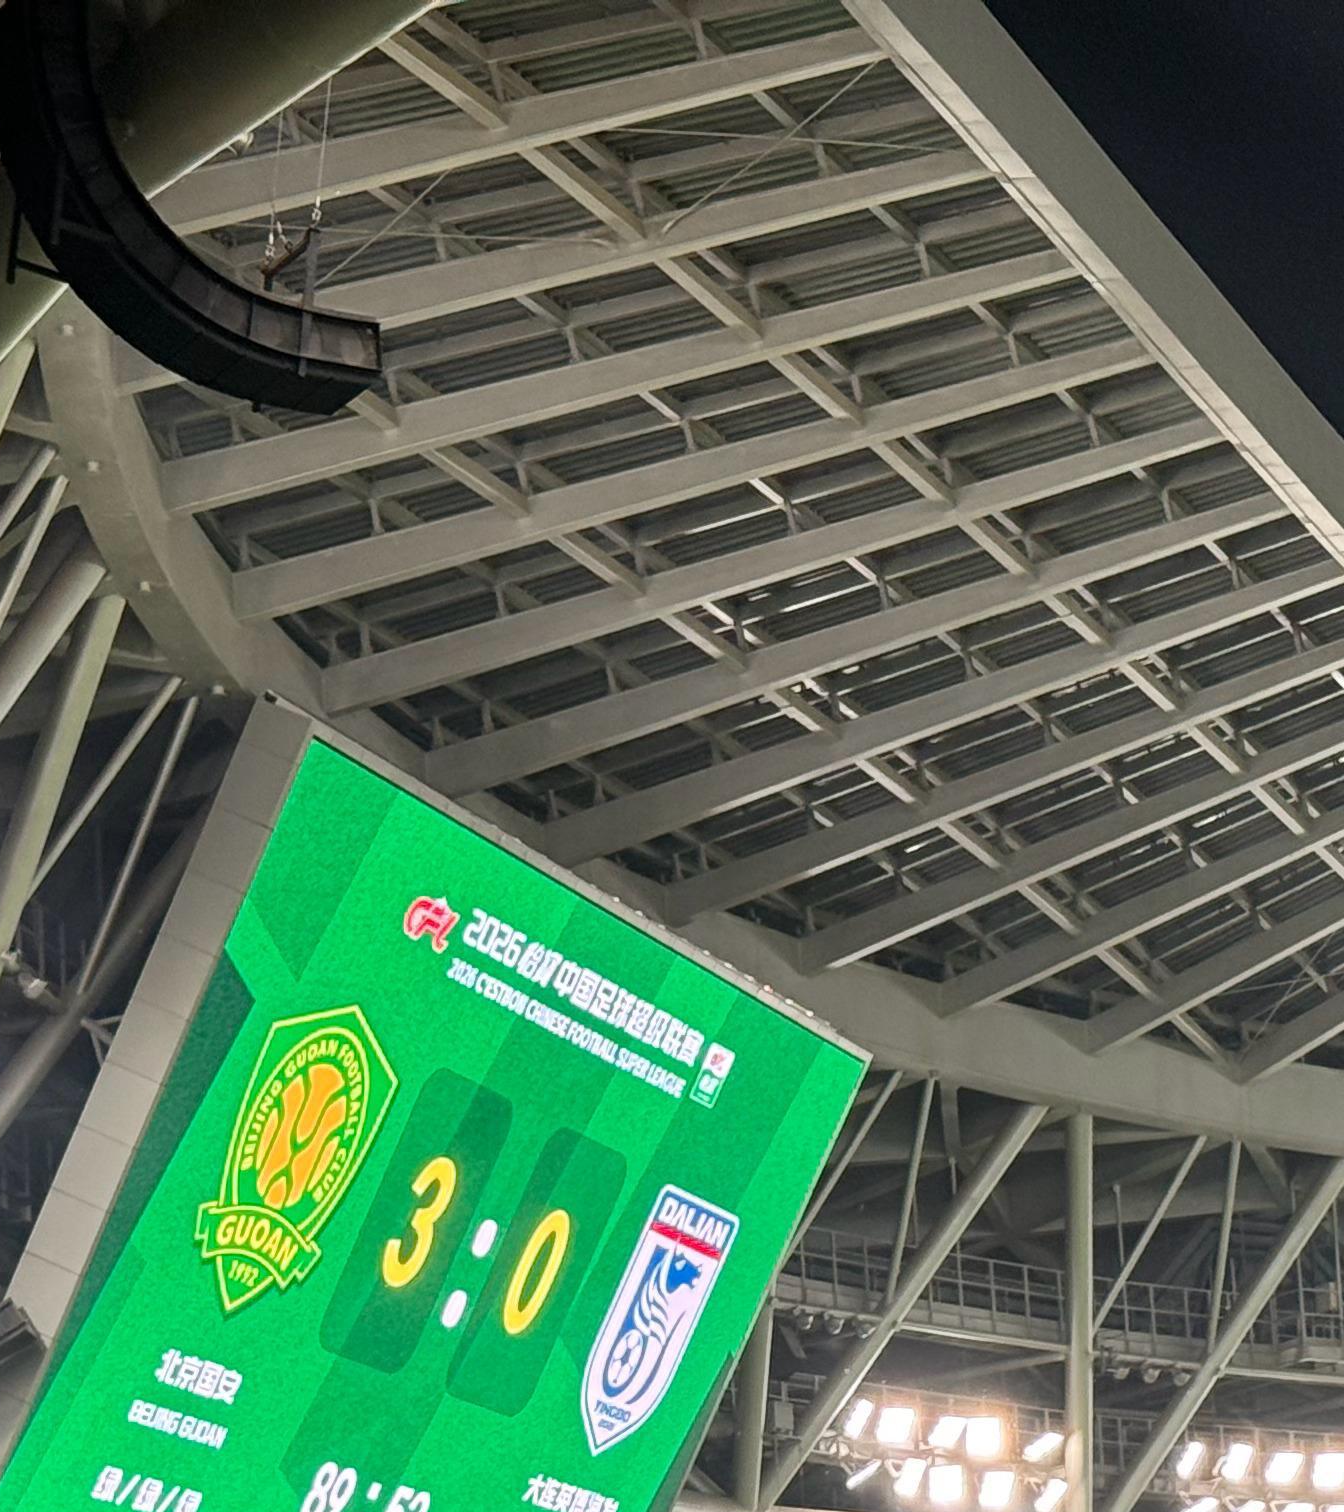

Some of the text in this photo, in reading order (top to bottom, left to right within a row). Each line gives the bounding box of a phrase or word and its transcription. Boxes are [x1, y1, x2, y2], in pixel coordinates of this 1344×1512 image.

[241, 1079, 284, 1171] BEIJING
[284, 1039, 340, 1080] GUOAN
[337, 1043, 365, 1142] FOOTBALL
[216, 1215, 299, 1271] GUOAN
[658, 1198, 730, 1249] DALIAN
[154, 1348, 243, 1405] 北京国安
